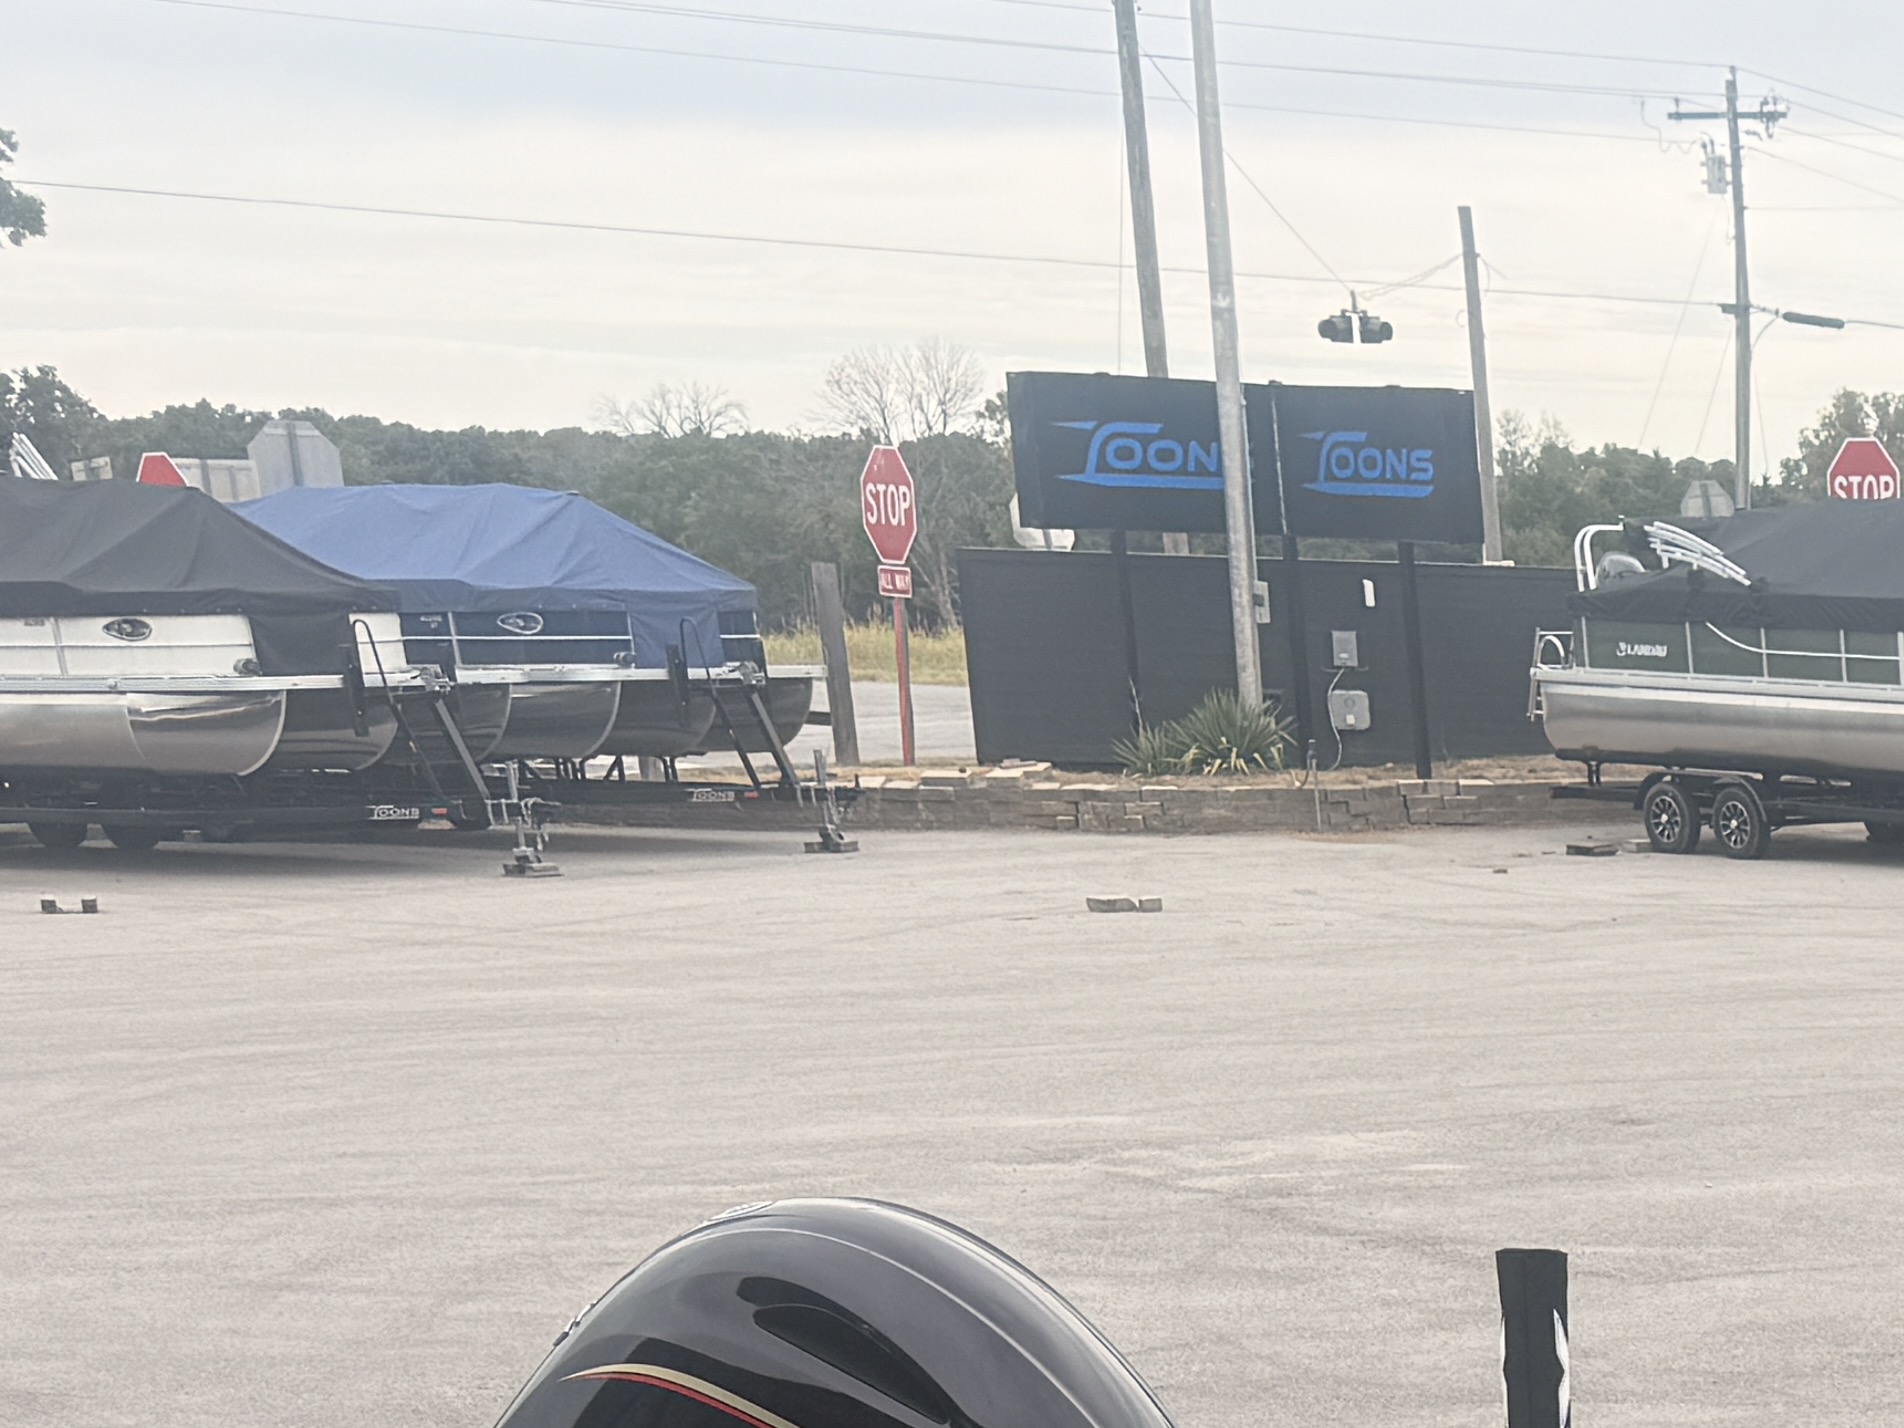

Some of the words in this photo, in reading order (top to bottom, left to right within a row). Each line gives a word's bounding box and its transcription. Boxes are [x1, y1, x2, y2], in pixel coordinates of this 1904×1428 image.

[1051, 420, 1224, 491] TOON
[1297, 431, 1435, 498] TOONS
[865, 482, 911, 527] STOP
[1833, 474, 1895, 500] STOP
